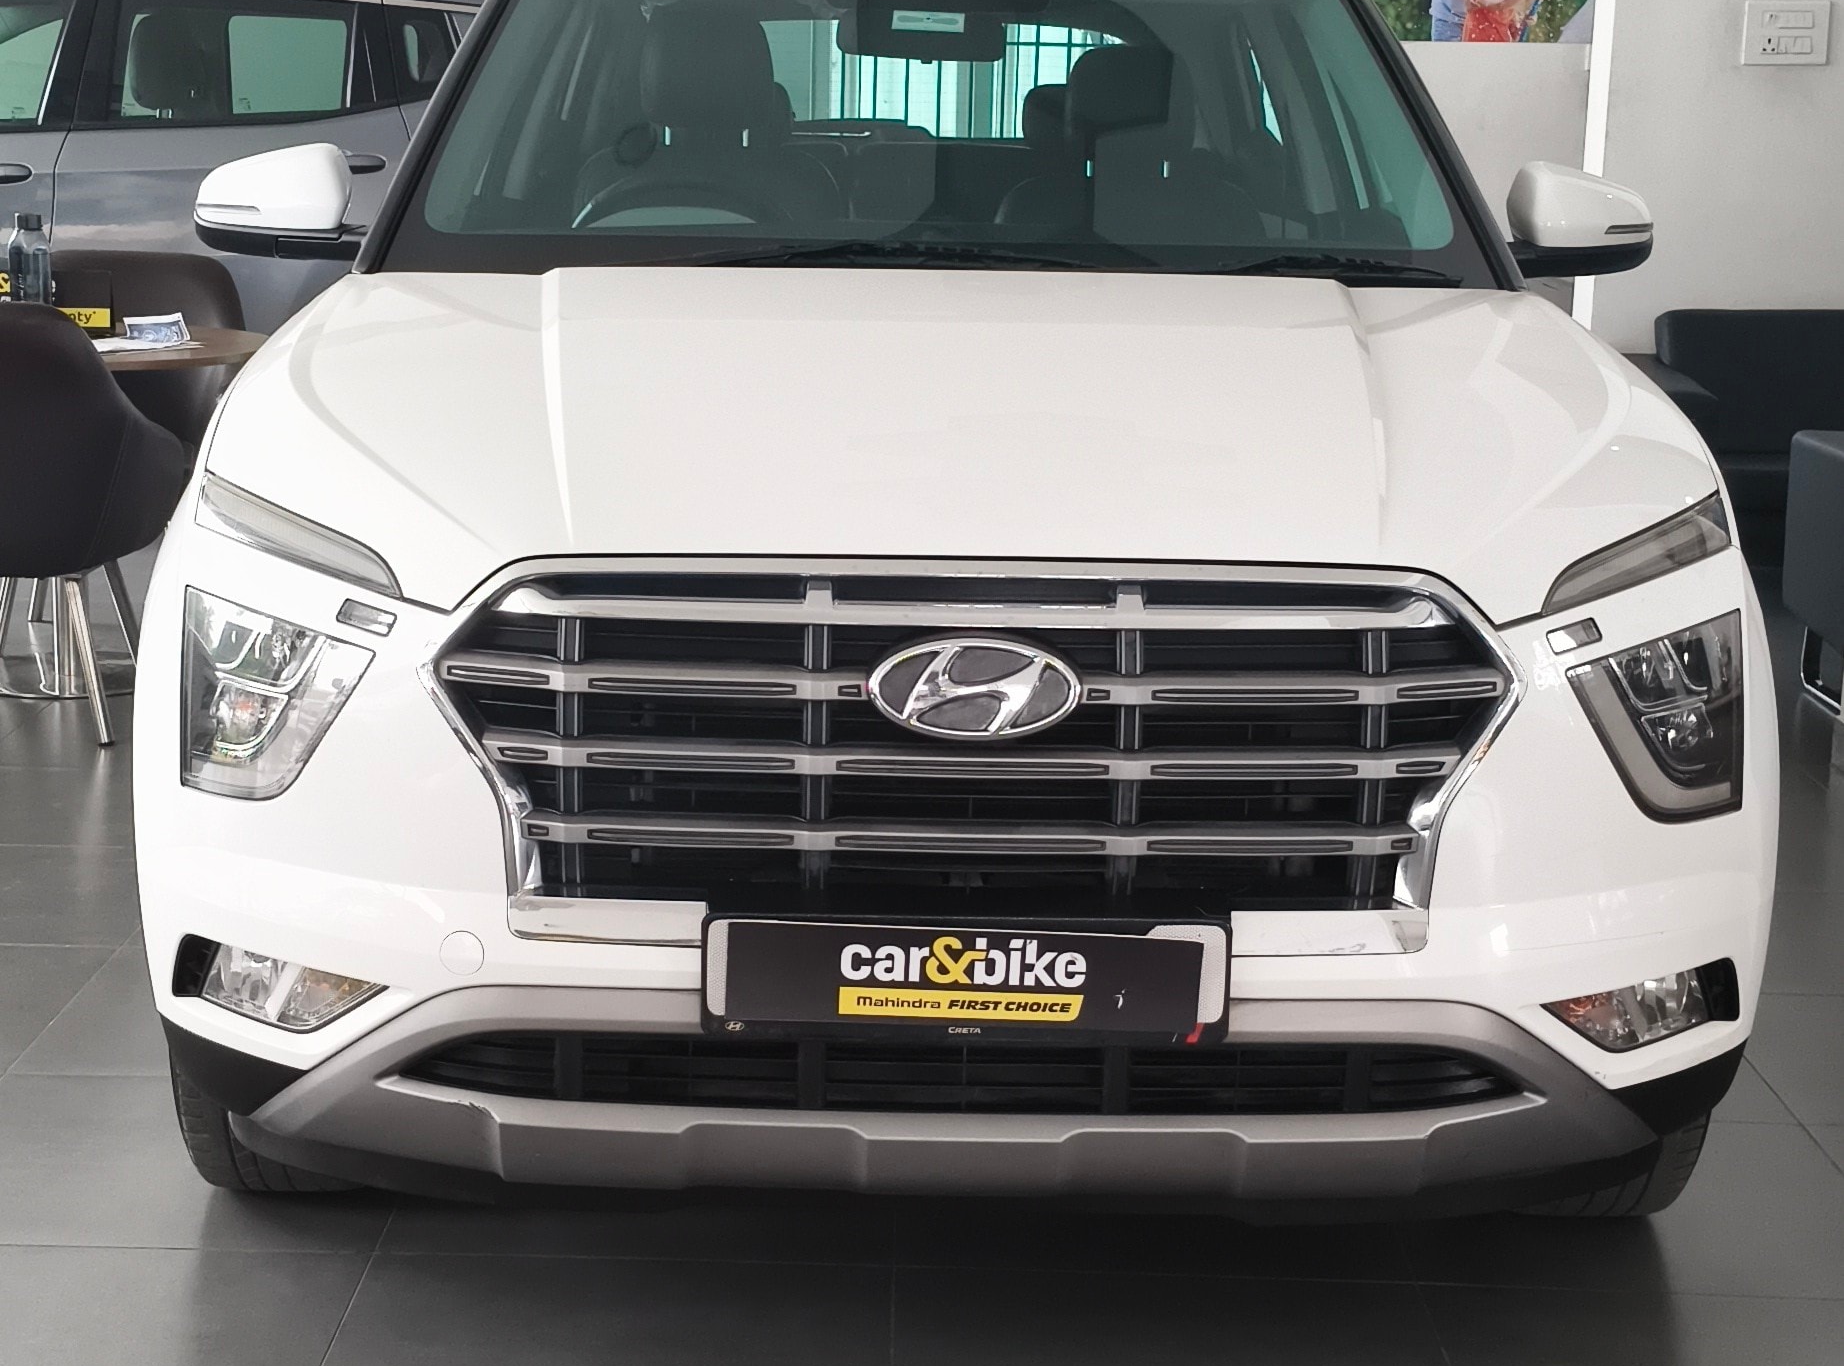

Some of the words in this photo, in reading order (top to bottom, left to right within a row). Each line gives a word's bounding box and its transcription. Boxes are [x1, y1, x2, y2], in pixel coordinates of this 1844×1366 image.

[839, 936, 1087, 988] car&bike
[855, 994, 942, 1010] Mahindra
[946, 998, 1003, 1013] FIRST
[1003, 1000, 1073, 1014] CHOICE
[947, 1025, 982, 1035] CRETA
